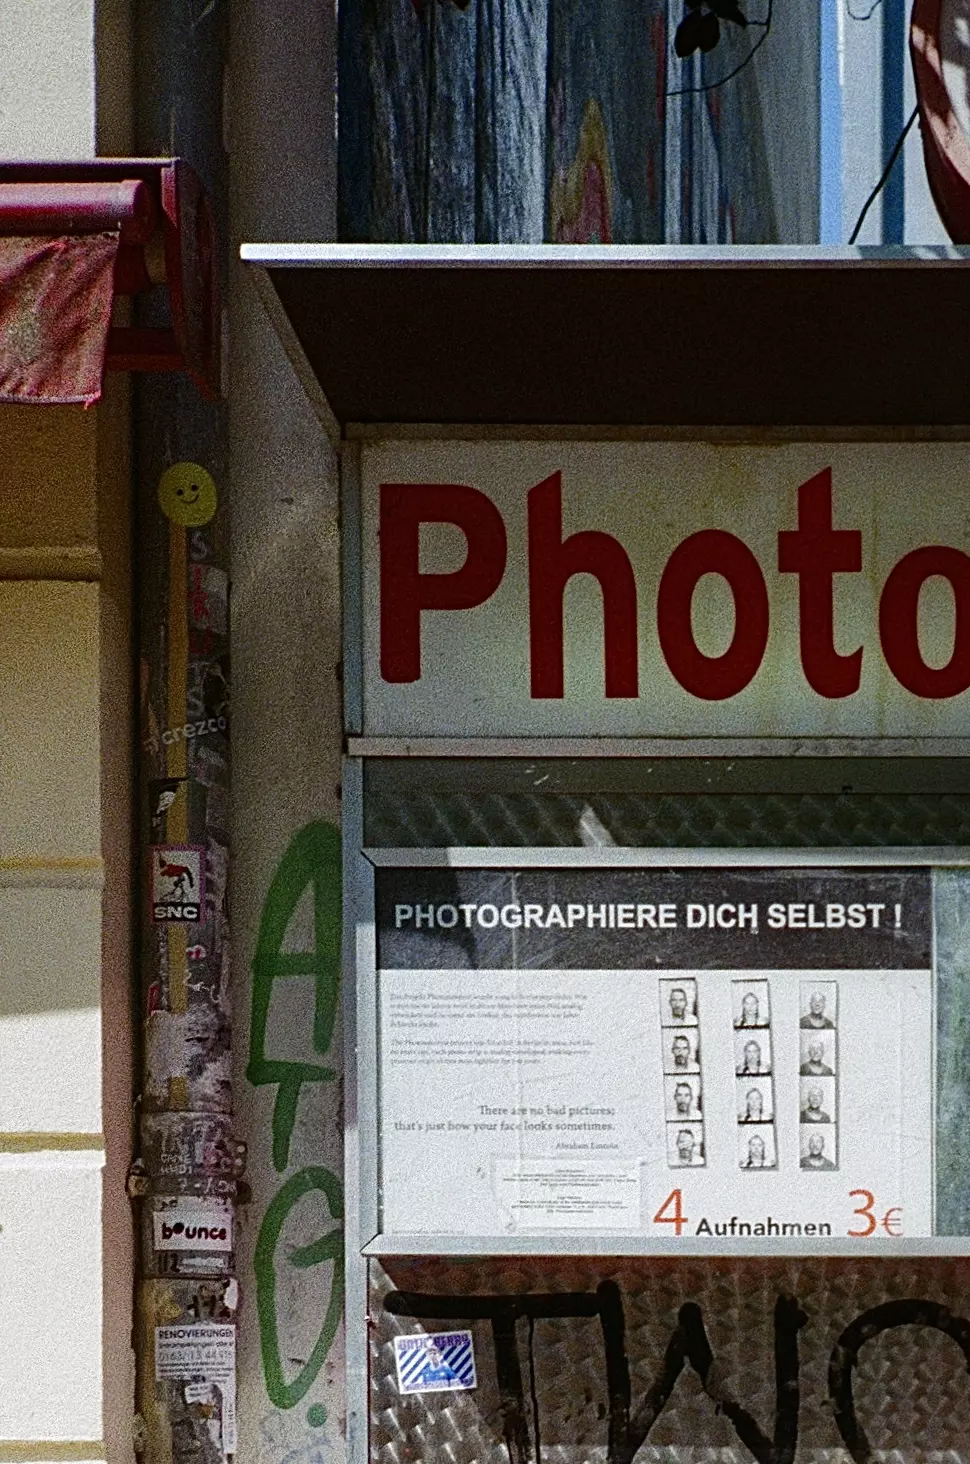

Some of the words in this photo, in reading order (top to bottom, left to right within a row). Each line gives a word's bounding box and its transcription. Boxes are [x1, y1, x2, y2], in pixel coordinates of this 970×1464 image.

[154, 906, 198, 920] SNC
[395, 903, 677, 928] PHOTOGRAPHIERE
[686, 903, 758, 928] DICH
[767, 903, 886, 928] SELBST
[425, 1121, 445, 1133] just
[473, 1122, 498, 1133] your
[523, 1121, 553, 1131] looks
[653, 1188, 688, 1236] 4
[695, 1216, 832, 1236] Aufnahmen
[161, 1222, 227, 1240] bounce
